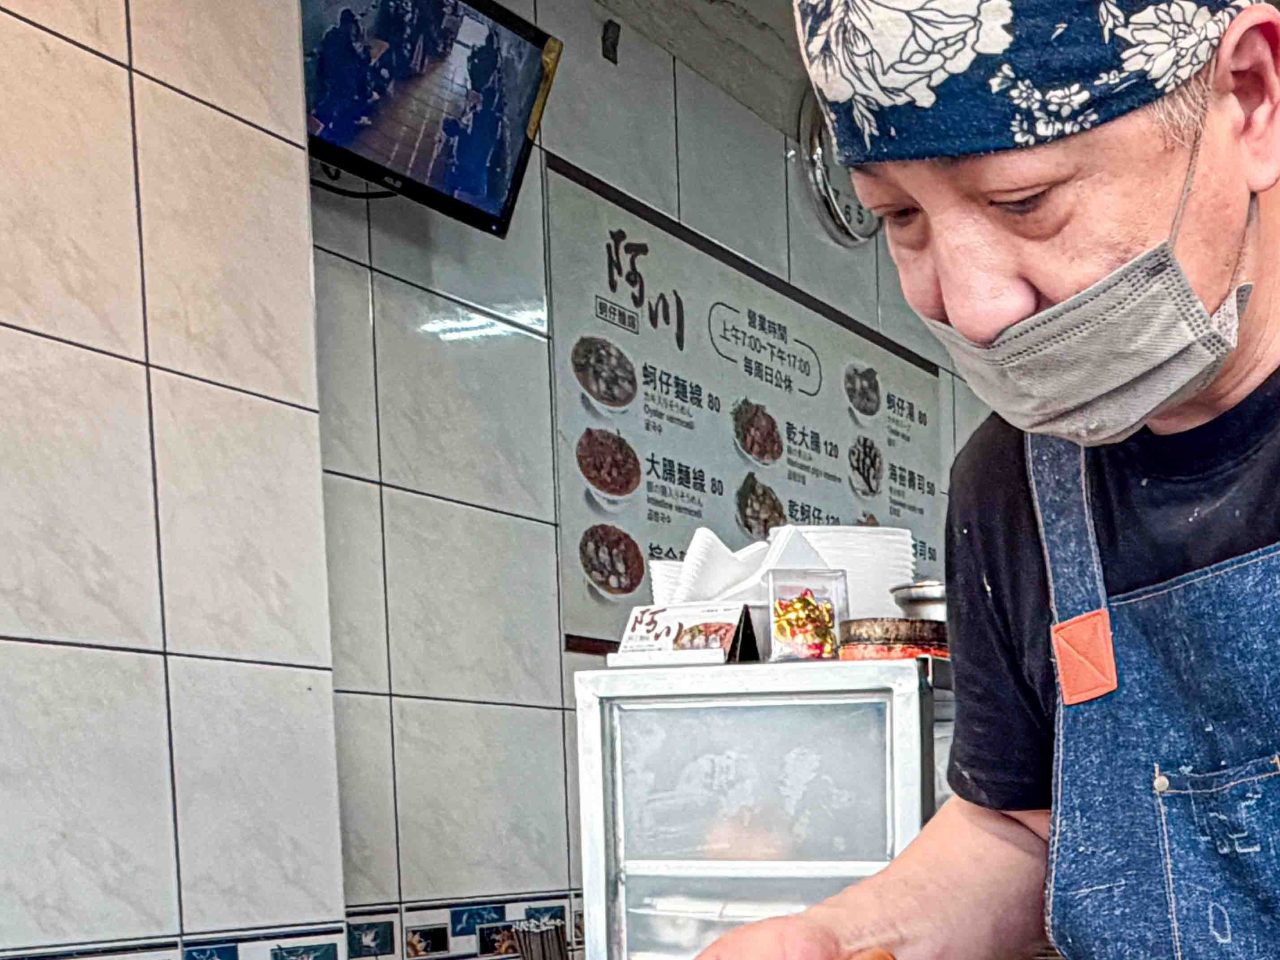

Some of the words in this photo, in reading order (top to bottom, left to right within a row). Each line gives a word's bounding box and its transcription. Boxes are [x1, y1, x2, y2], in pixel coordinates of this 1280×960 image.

[708, 392, 721, 413] 80
[824, 440, 839, 459] 120
[711, 477, 724, 497] 80
